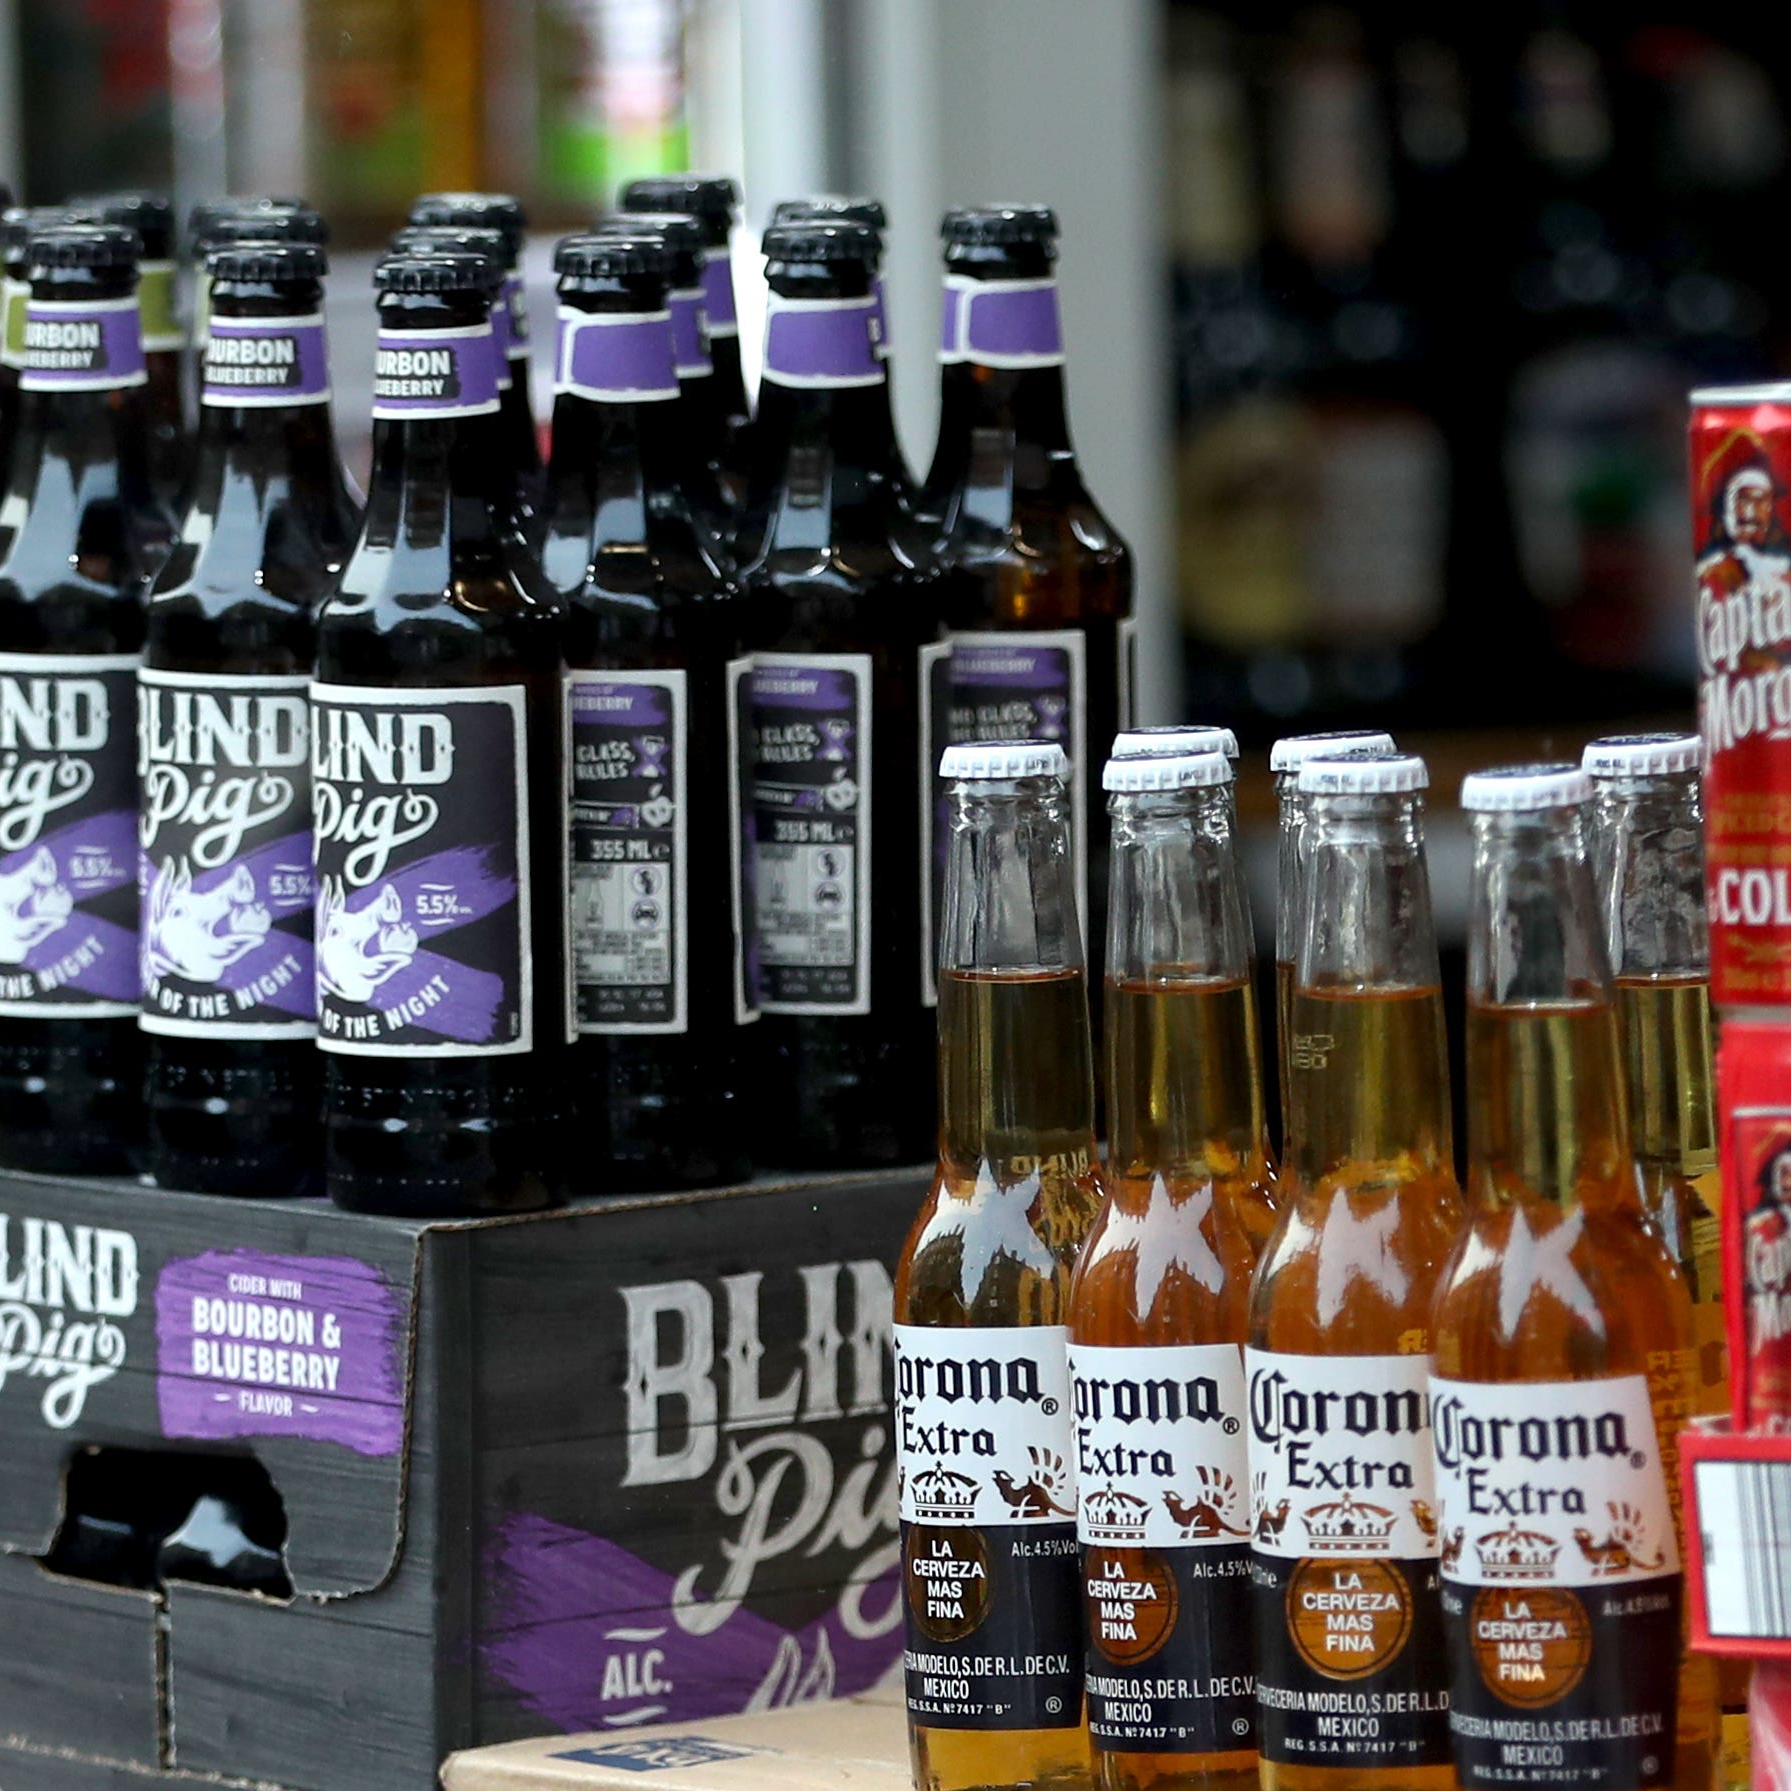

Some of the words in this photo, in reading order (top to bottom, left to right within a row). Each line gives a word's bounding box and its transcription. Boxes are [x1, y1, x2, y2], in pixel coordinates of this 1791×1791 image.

[208, 338, 296, 364] OURBON
[137, 764, 295, 869] Pig
[415, 893, 460, 915] 5.5%
[185, 991, 230, 1020] THE
[234, 958, 303, 1011] NIGHT
[343, 1010, 381, 1040] THE
[383, 974, 452, 1032] NIGHT
[227, 1273, 269, 1298] CIDER
[270, 1276, 303, 1302] WITH
[191, 1296, 315, 1345] BOURBON
[320, 1313, 342, 1350] &
[191, 1338, 341, 1392] BLUEBERRY
[238, 1391, 294, 1418] FLAVOR
[901, 1405, 998, 1457] Extra
[1431, 1391, 1634, 1478] Corona
[1077, 1427, 1177, 1479] Extra
[1286, 1441, 1415, 1492] Extra
[1466, 1467, 1587, 1517] Extra
[931, 1539, 953, 1558] LA
[912, 1558, 985, 1579] CERVEZA
[1103, 1560, 1125, 1579] LA
[927, 1580, 963, 1599] MAS
[1087, 1579, 1158, 1601] CERVEZA
[1334, 1572, 1363, 1591] LA
[927, 1601, 965, 1620] FINA
[1100, 1601, 1136, 1621] MAS
[1302, 1592, 1401, 1611] CERVEZA
[1503, 1600, 1531, 1619] LA
[1101, 1622, 1138, 1641] FINA
[1326, 1613, 1374, 1632] MAS
[1477, 1620, 1569, 1641] CERVEZA
[1325, 1634, 1375, 1652] FINA
[1497, 1642, 1544, 1662] MAS
[601, 1650, 673, 1701] ALC.
[1497, 1662, 1546, 1682] FINA
[923, 1677, 970, 1700] MEXICO
[956, 1703, 983, 1715] 7417
[1104, 1701, 1153, 1724] MEXICO
[1317, 1716, 1380, 1738] MEXICO
[1502, 1744, 1564, 1767] MEXICO
